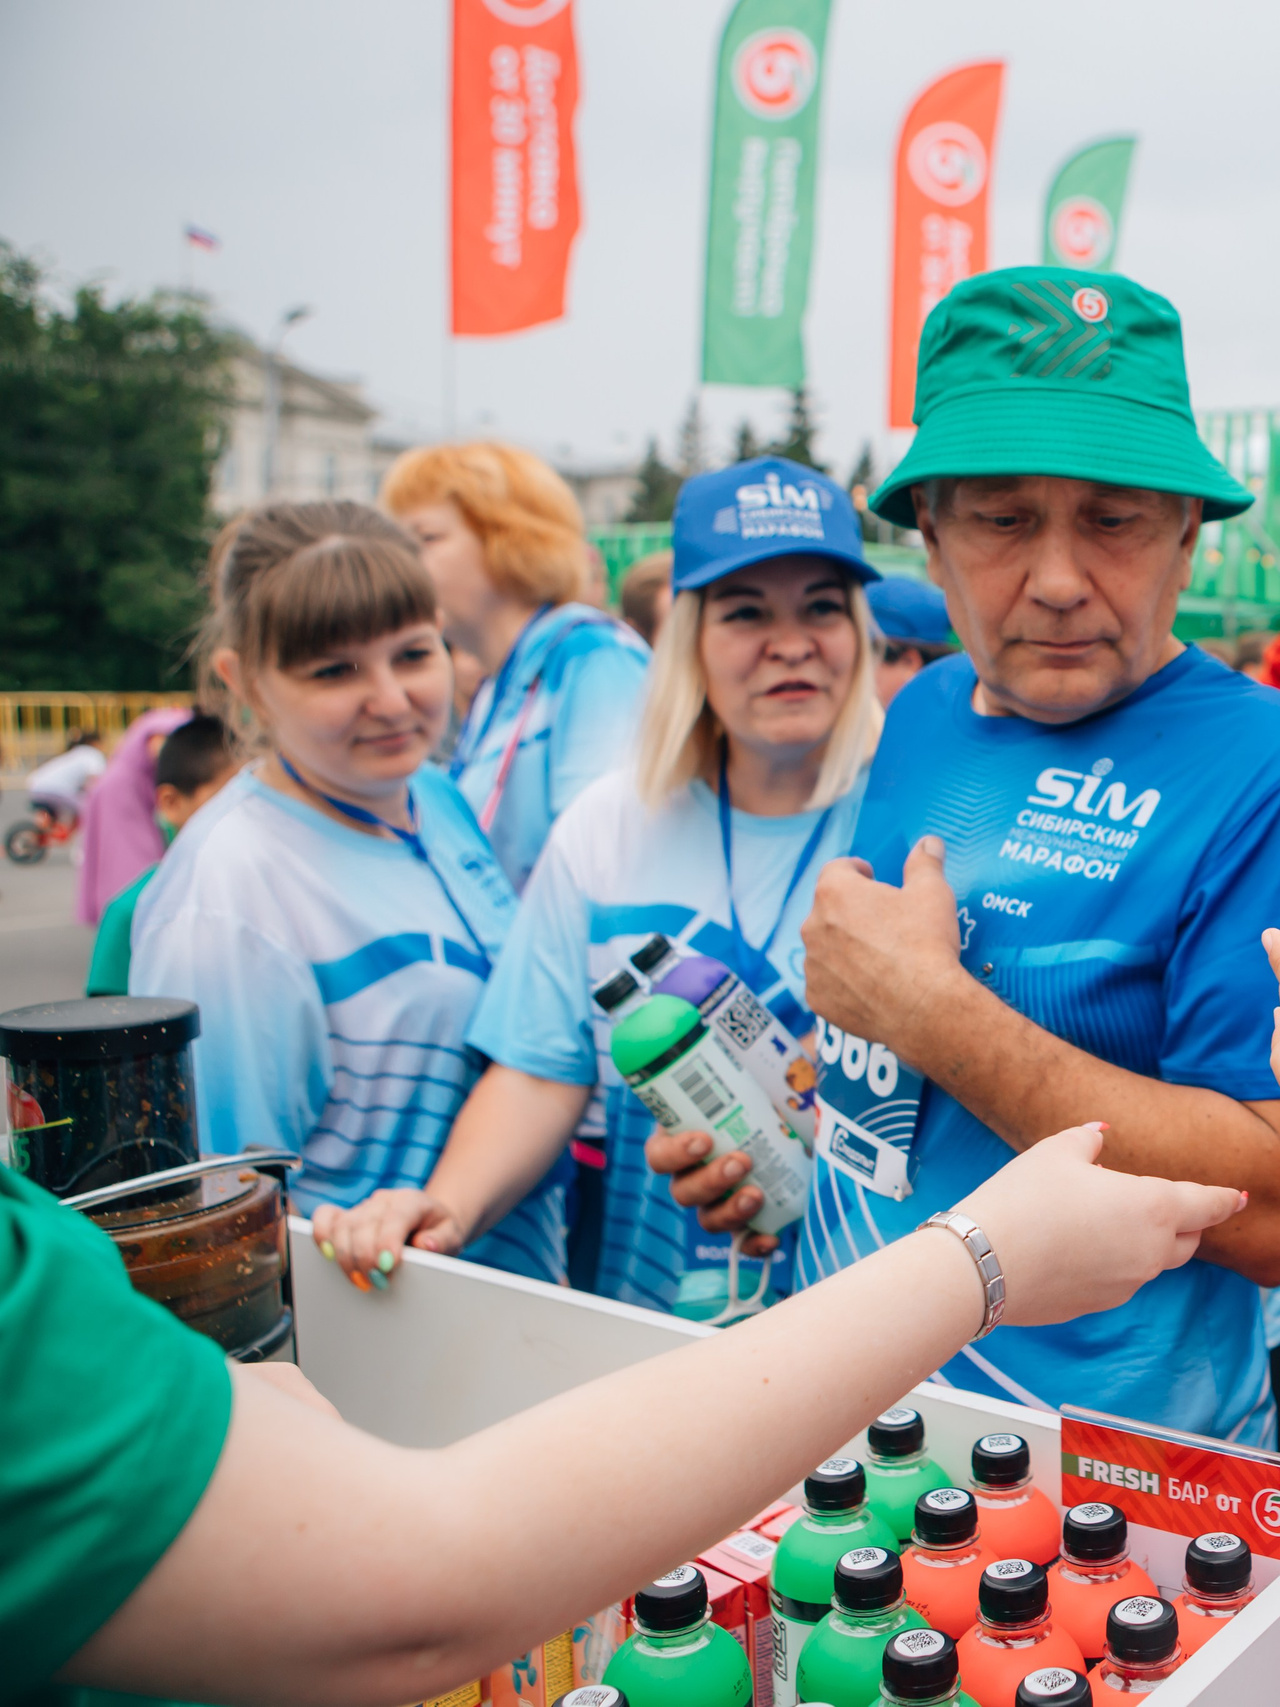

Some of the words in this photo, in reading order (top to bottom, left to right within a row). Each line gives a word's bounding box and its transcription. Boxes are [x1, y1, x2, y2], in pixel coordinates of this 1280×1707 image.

[1016, 808, 1139, 849] СИБИРСКИЙ
[999, 838, 1121, 882] МАРАФОН
[982, 891, 1034, 918] ОМСК
[1077, 1455, 1160, 1496] FRESH
[1168, 1477, 1209, 1505] БАР
